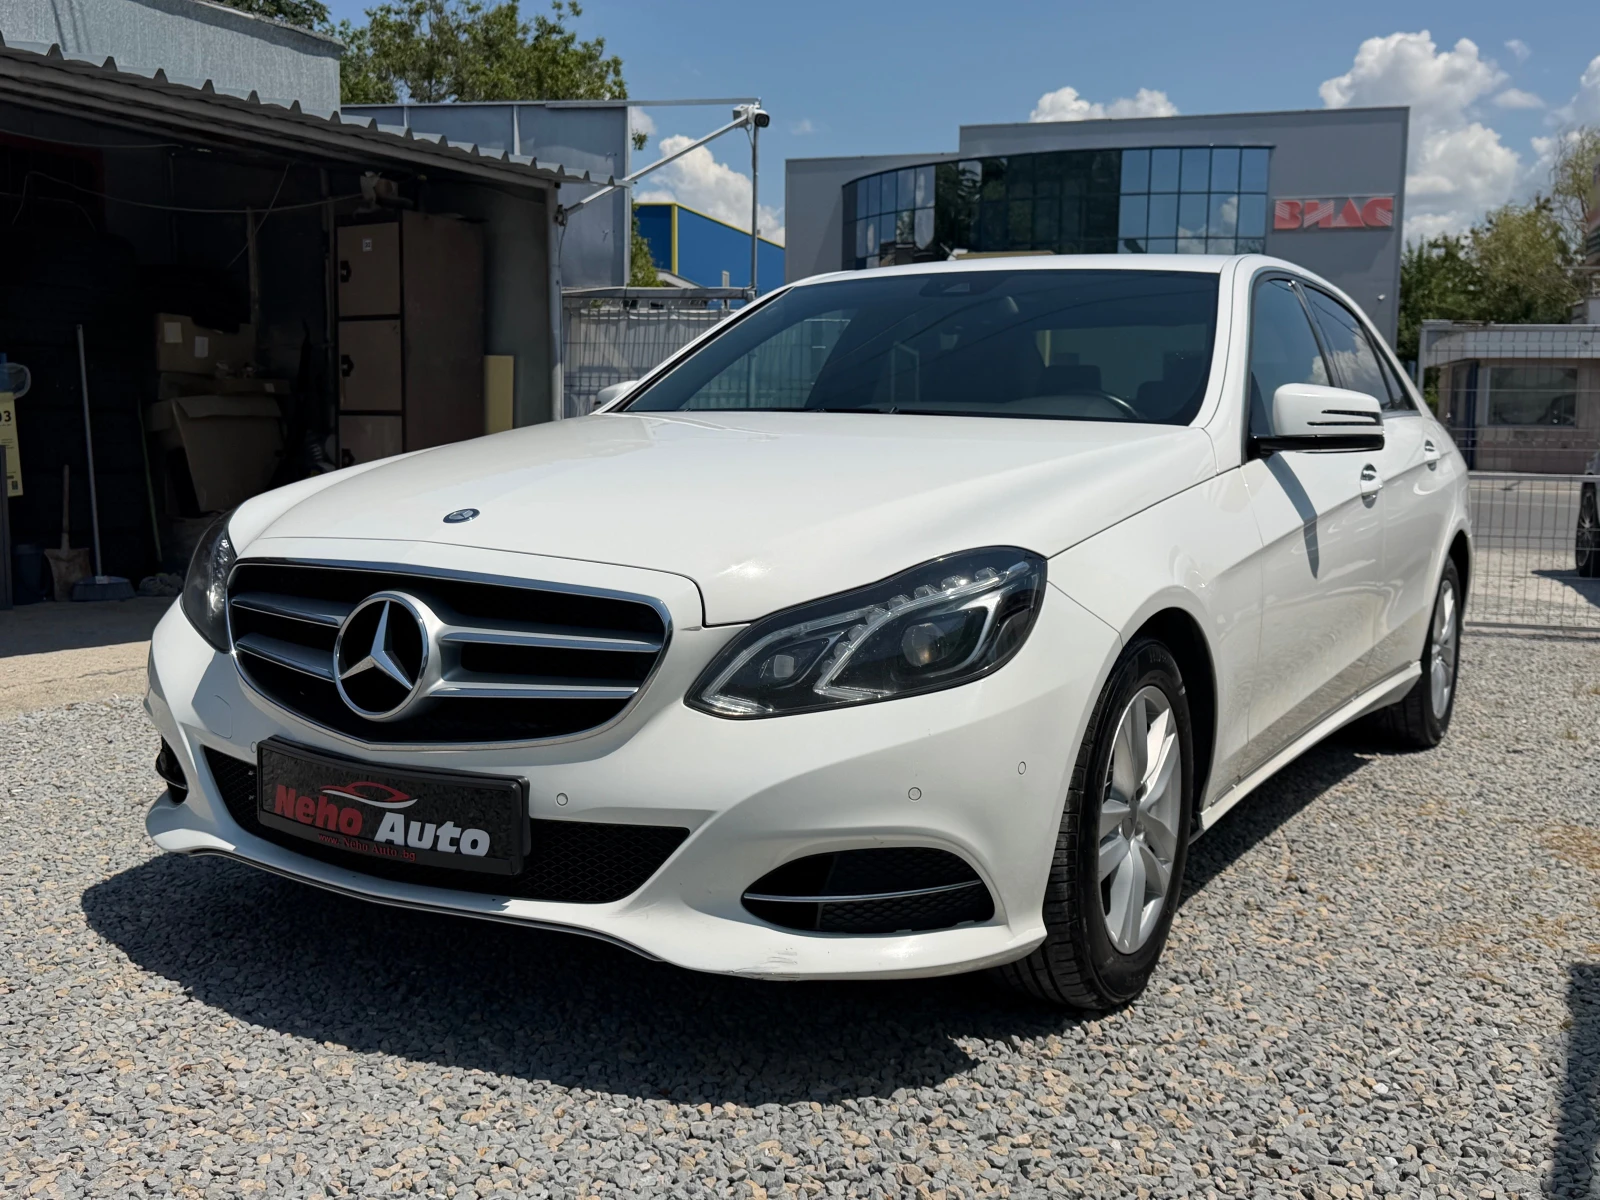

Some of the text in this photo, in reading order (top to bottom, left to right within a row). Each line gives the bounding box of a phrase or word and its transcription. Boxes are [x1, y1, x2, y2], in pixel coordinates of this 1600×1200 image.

[274, 784, 490, 857] Neho Auto
[343, 838, 368, 852] Neho
[371, 845, 398, 857] Auto
